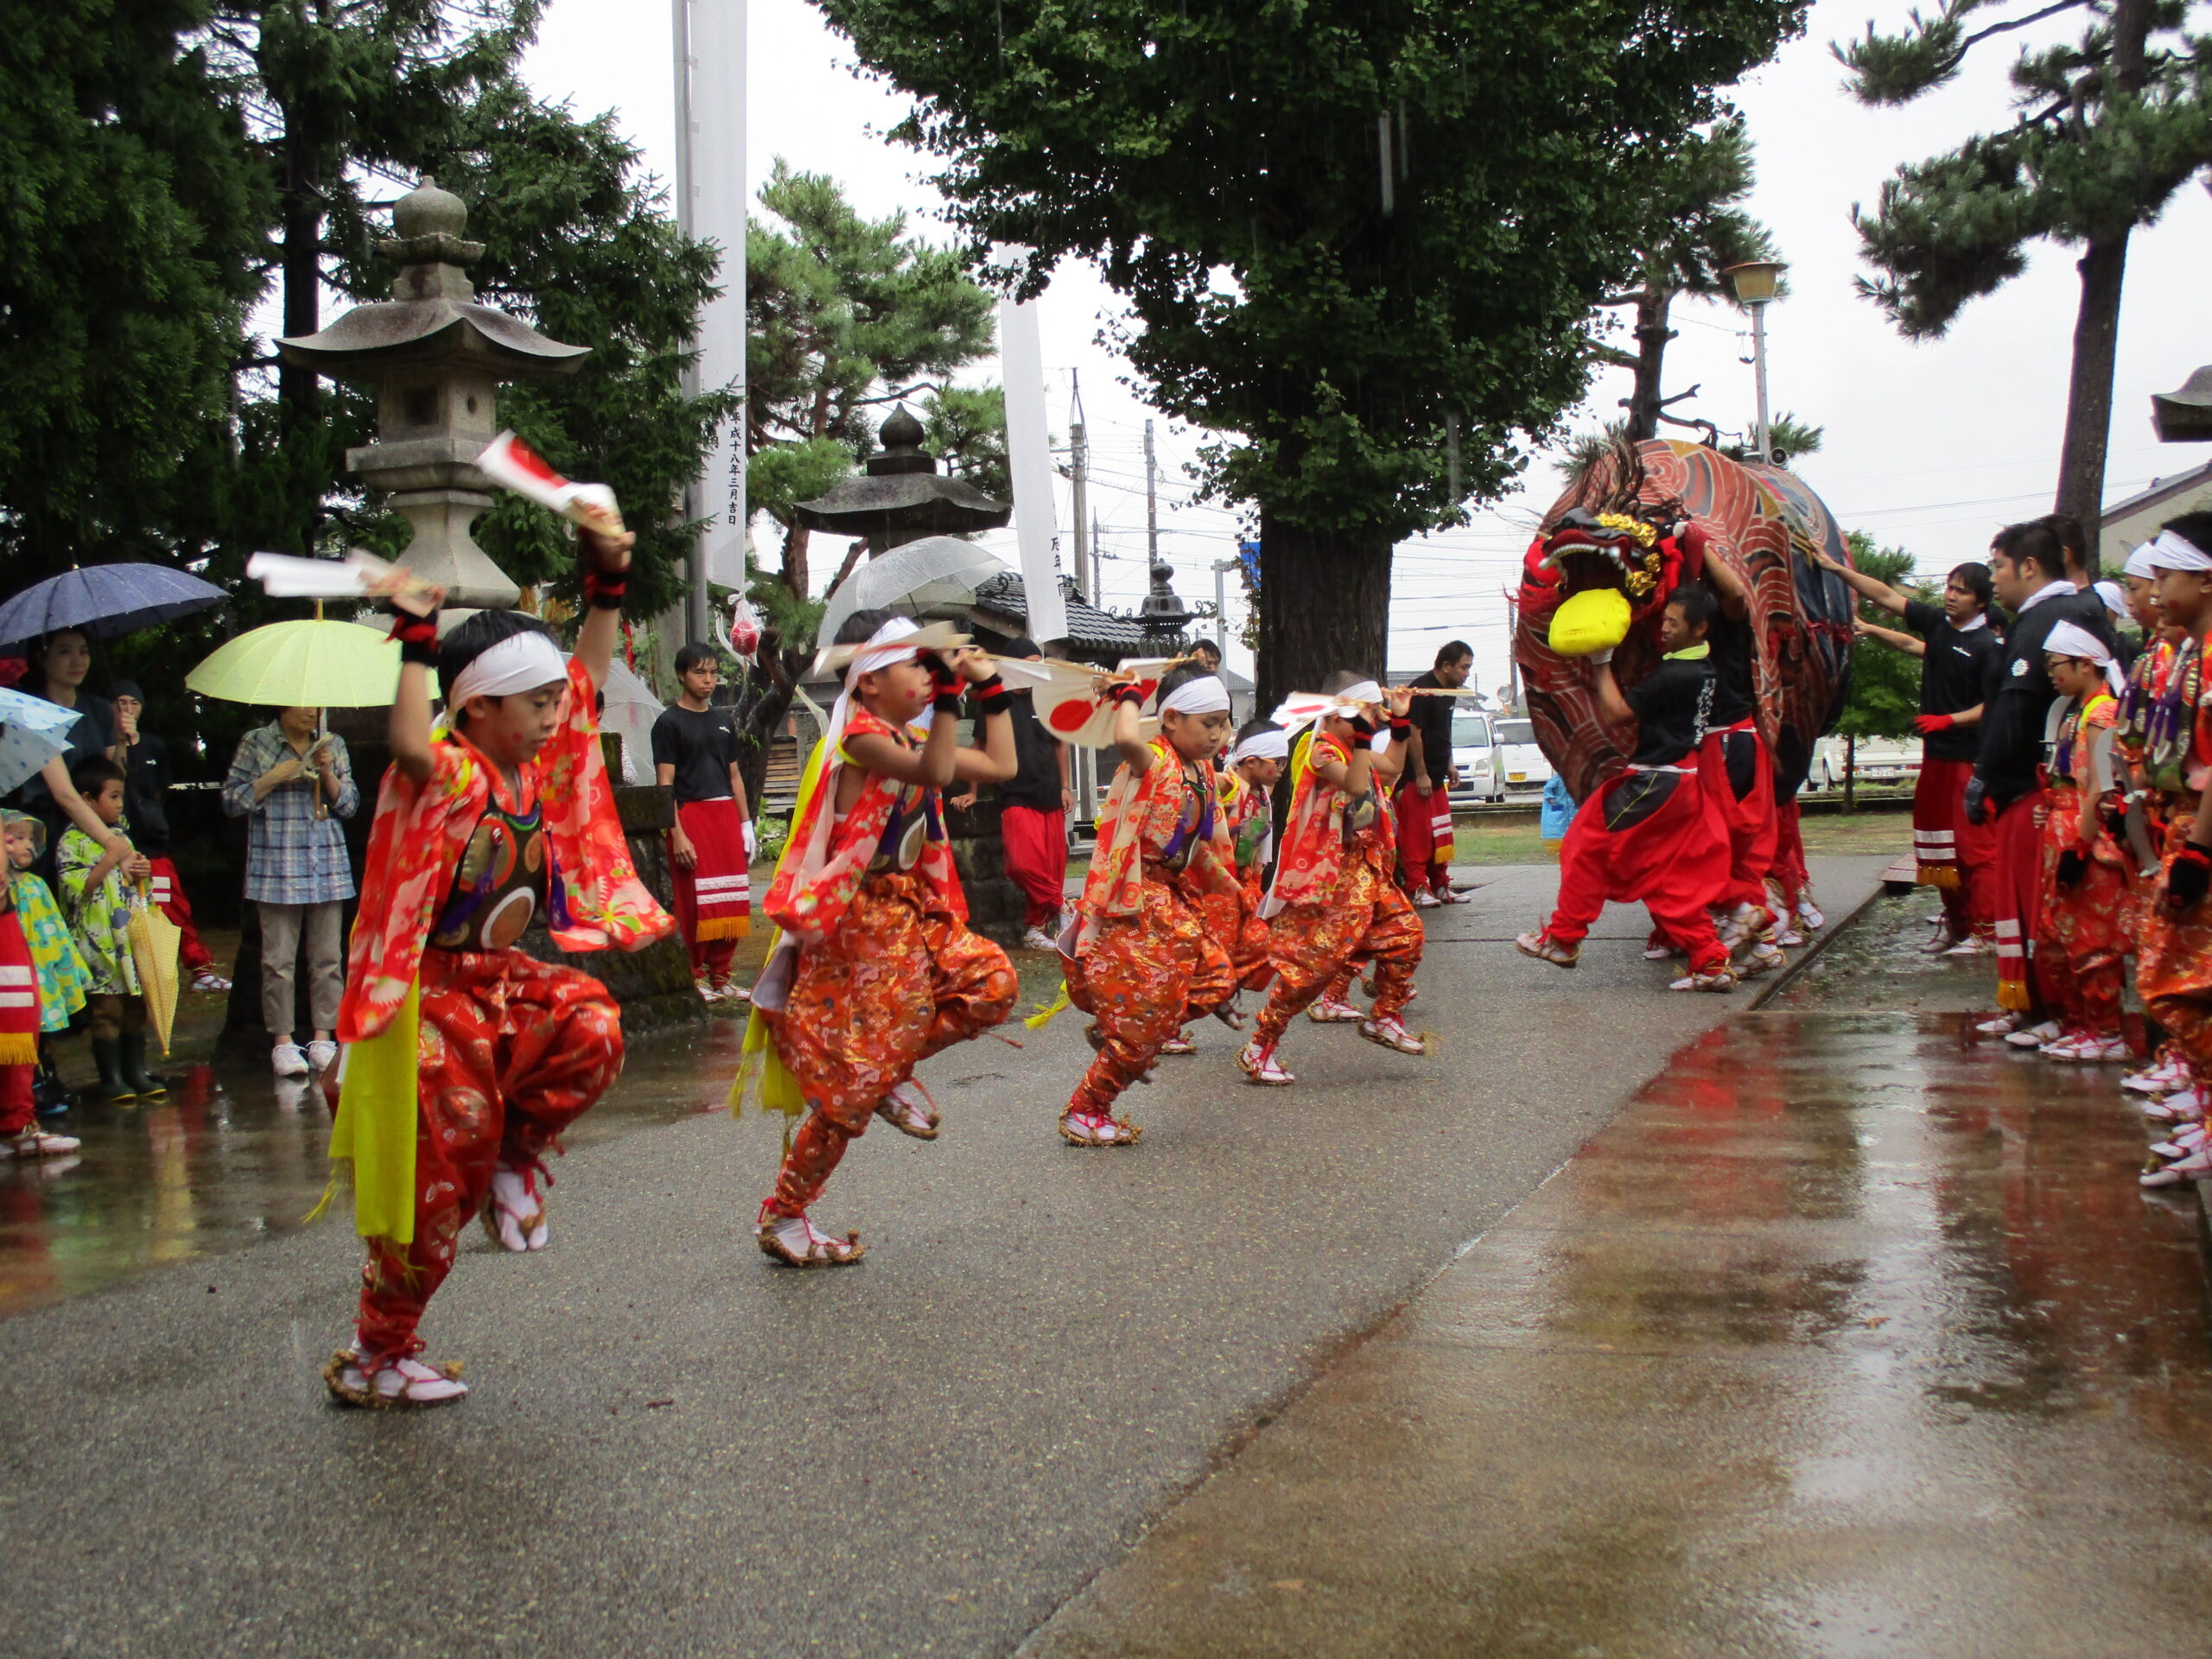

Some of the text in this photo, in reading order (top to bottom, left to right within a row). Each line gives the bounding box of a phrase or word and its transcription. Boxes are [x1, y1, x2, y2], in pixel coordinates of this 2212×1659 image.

[728, 411, 741, 524] 平成十八年三月吉日
